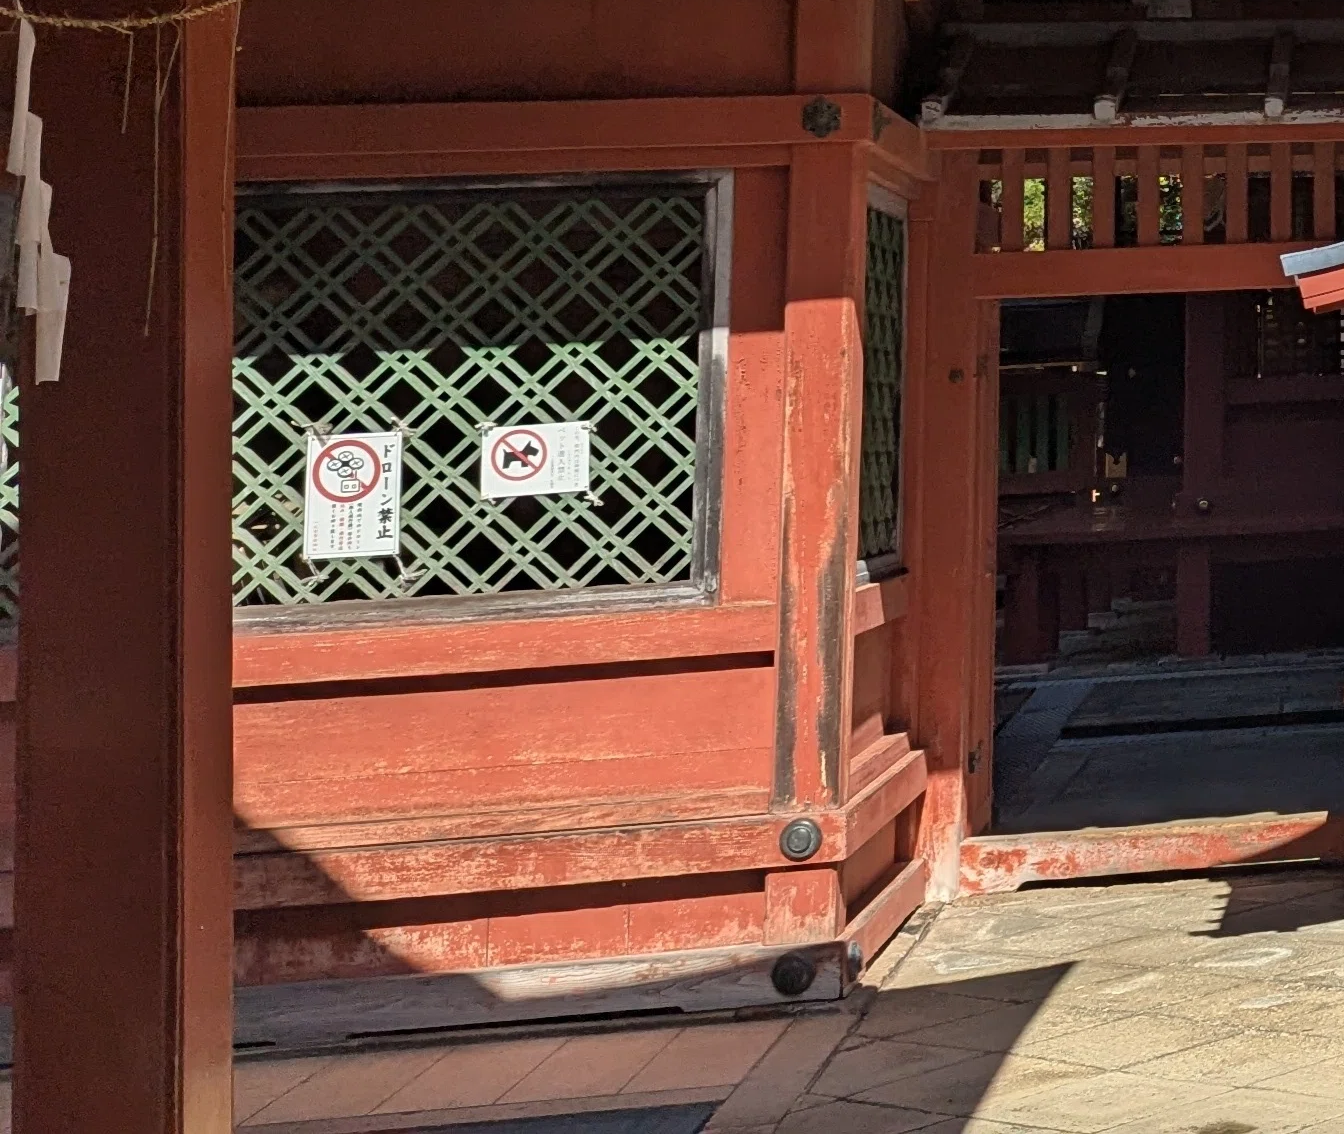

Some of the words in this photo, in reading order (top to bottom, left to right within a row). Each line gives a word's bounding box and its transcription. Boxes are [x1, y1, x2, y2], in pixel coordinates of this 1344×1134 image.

[376, 444, 395, 540] ドローン禁止
